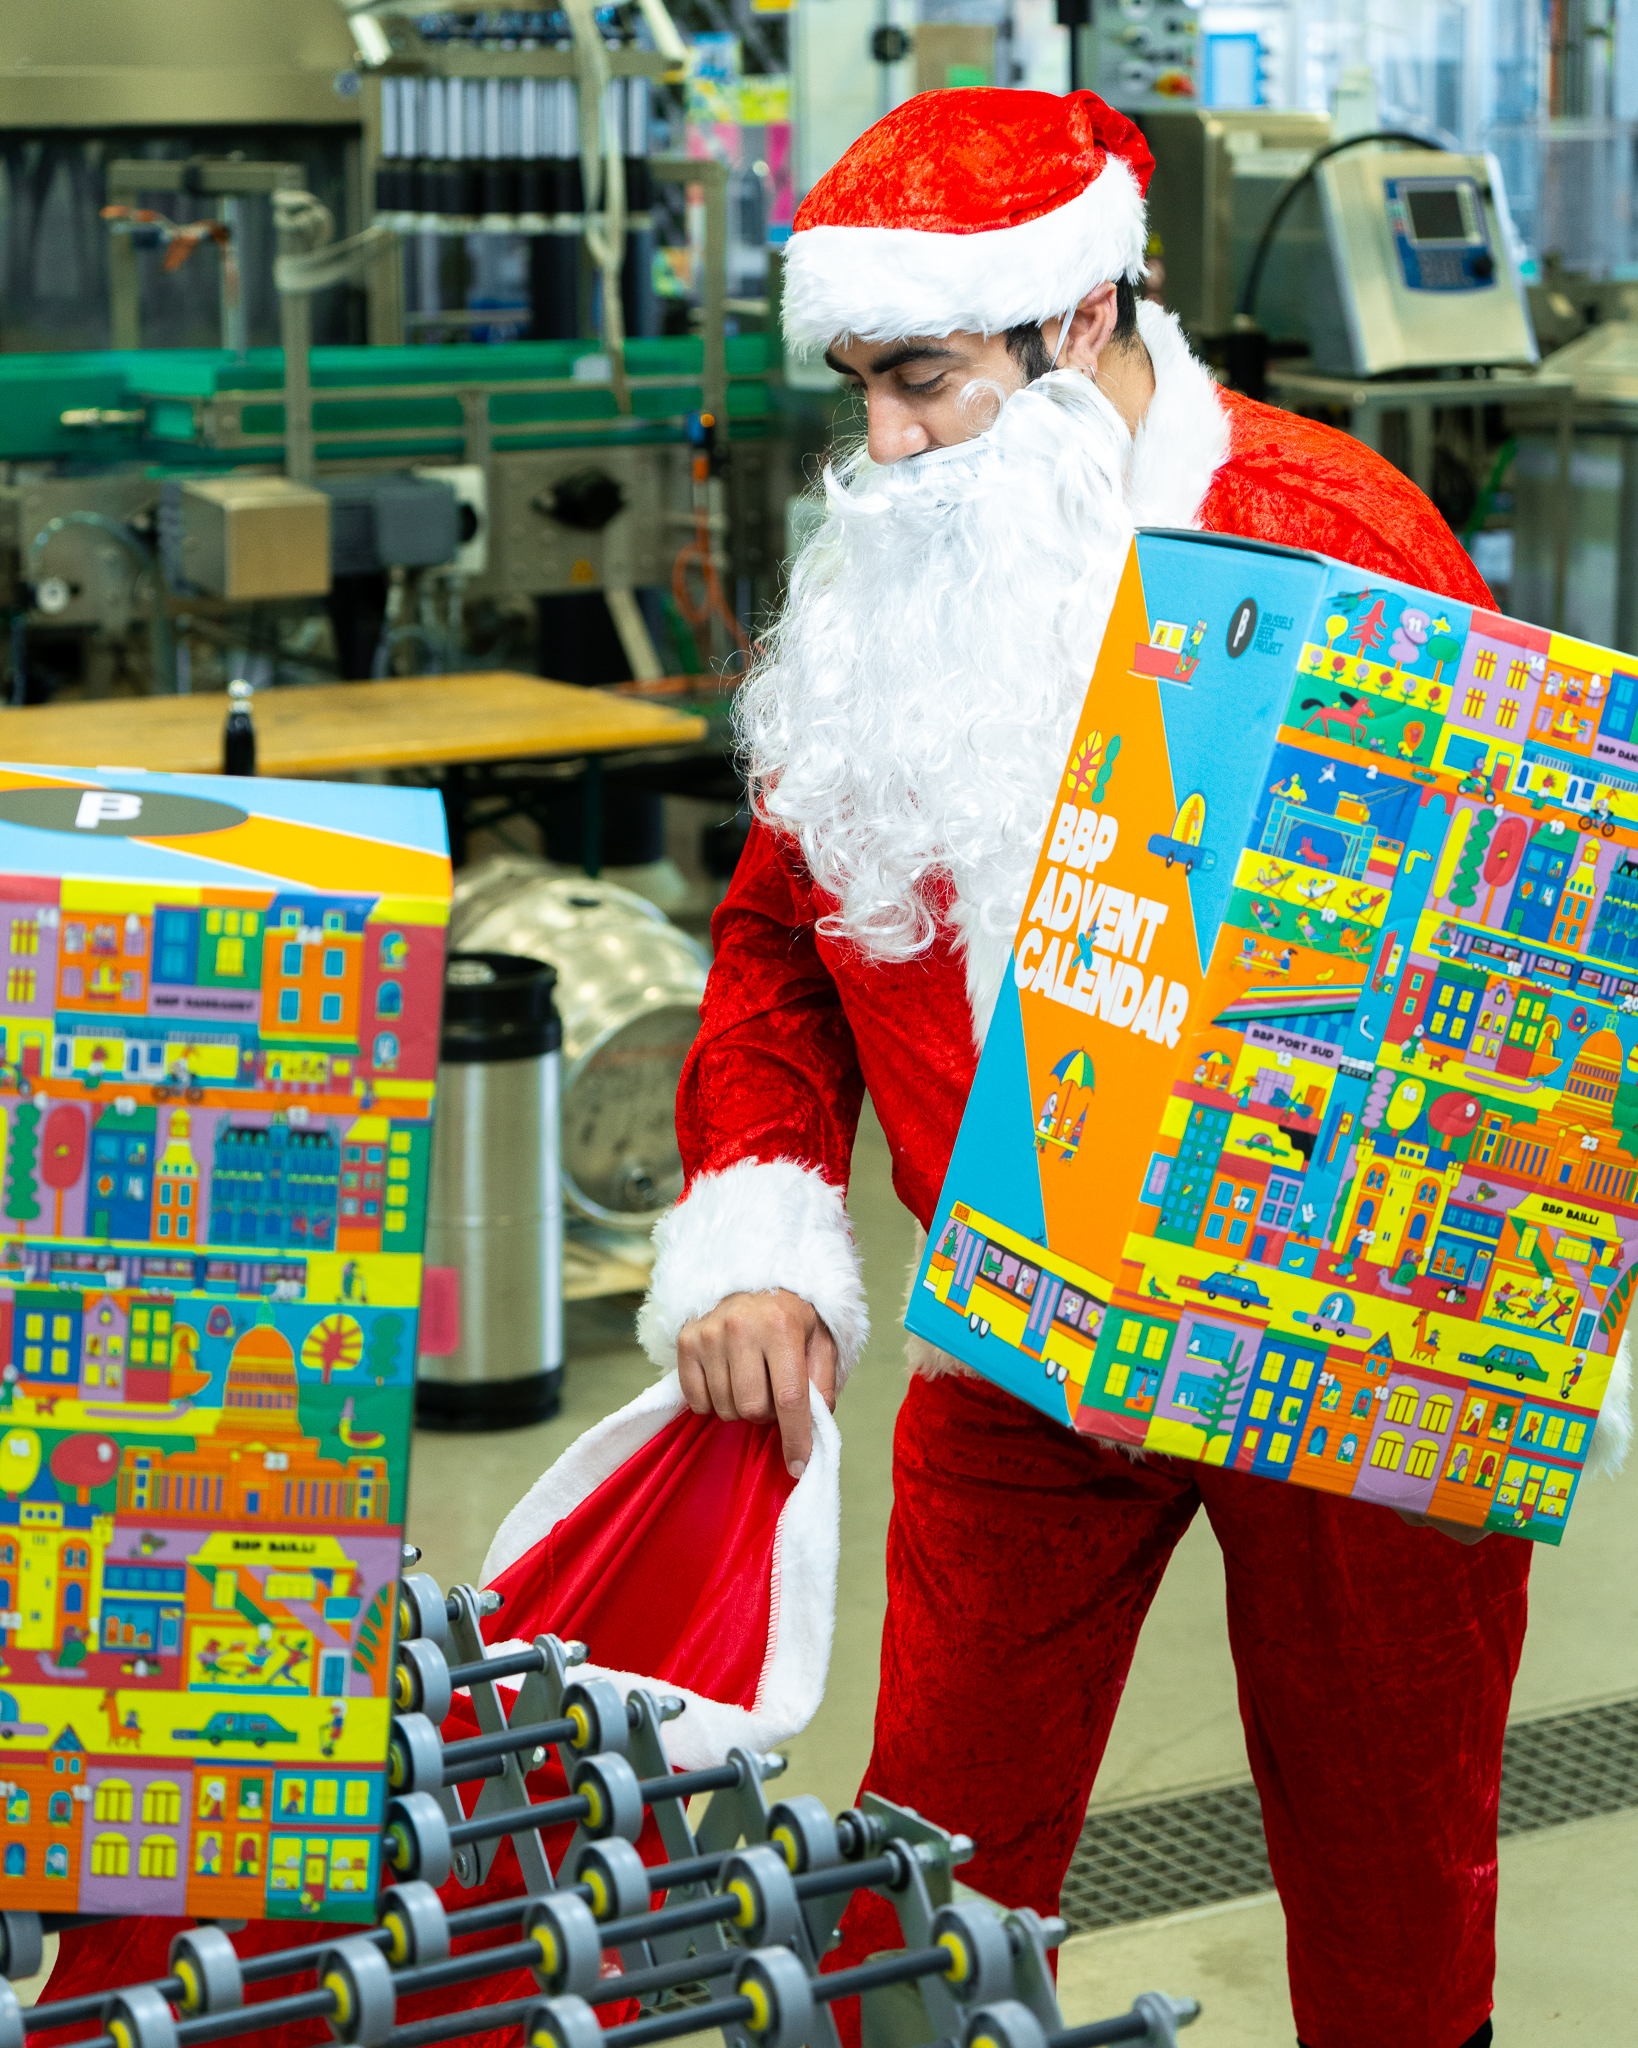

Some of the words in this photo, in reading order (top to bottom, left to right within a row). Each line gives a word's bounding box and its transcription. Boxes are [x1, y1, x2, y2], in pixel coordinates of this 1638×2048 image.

[1408, 617, 1422, 633] 11
[1530, 655, 1546, 672] 14
[1597, 743, 1616, 754] BBP
[1618, 750, 1638, 763] DAN
[1366, 764, 1378, 780] 2
[1550, 819, 1566, 835] 19
[1047, 802, 1118, 874] BBP
[1028, 867, 1168, 964] ADVENT
[1320, 907, 1337, 924] 10
[1450, 944, 1460, 957] 7
[1507, 961, 1522, 976] 15
[1014, 928, 1189, 1050] CALENDAR
[1252, 1029, 1274, 1042] BBP
[1277, 1035, 1307, 1051] PORT
[1310, 1045, 1334, 1059] SUD
[1277, 1051, 1293, 1067] 12
[1403, 1086, 1417, 1102] 16
[1466, 1103, 1476, 1117] 9
[1581, 1135, 1599, 1152] 23
[1234, 1195, 1250, 1211] 17
[1542, 1203, 1563, 1215] BBP
[1566, 1210, 1599, 1225] BAILLI
[1357, 1229, 1376, 1245] 22
[1424, 1246, 1432, 1259] 1
[1189, 1340, 1200, 1352] 4
[1318, 1372, 1335, 1386] 21
[1375, 1386, 1389, 1400] 18
[1497, 1417, 1508, 1430] 3
